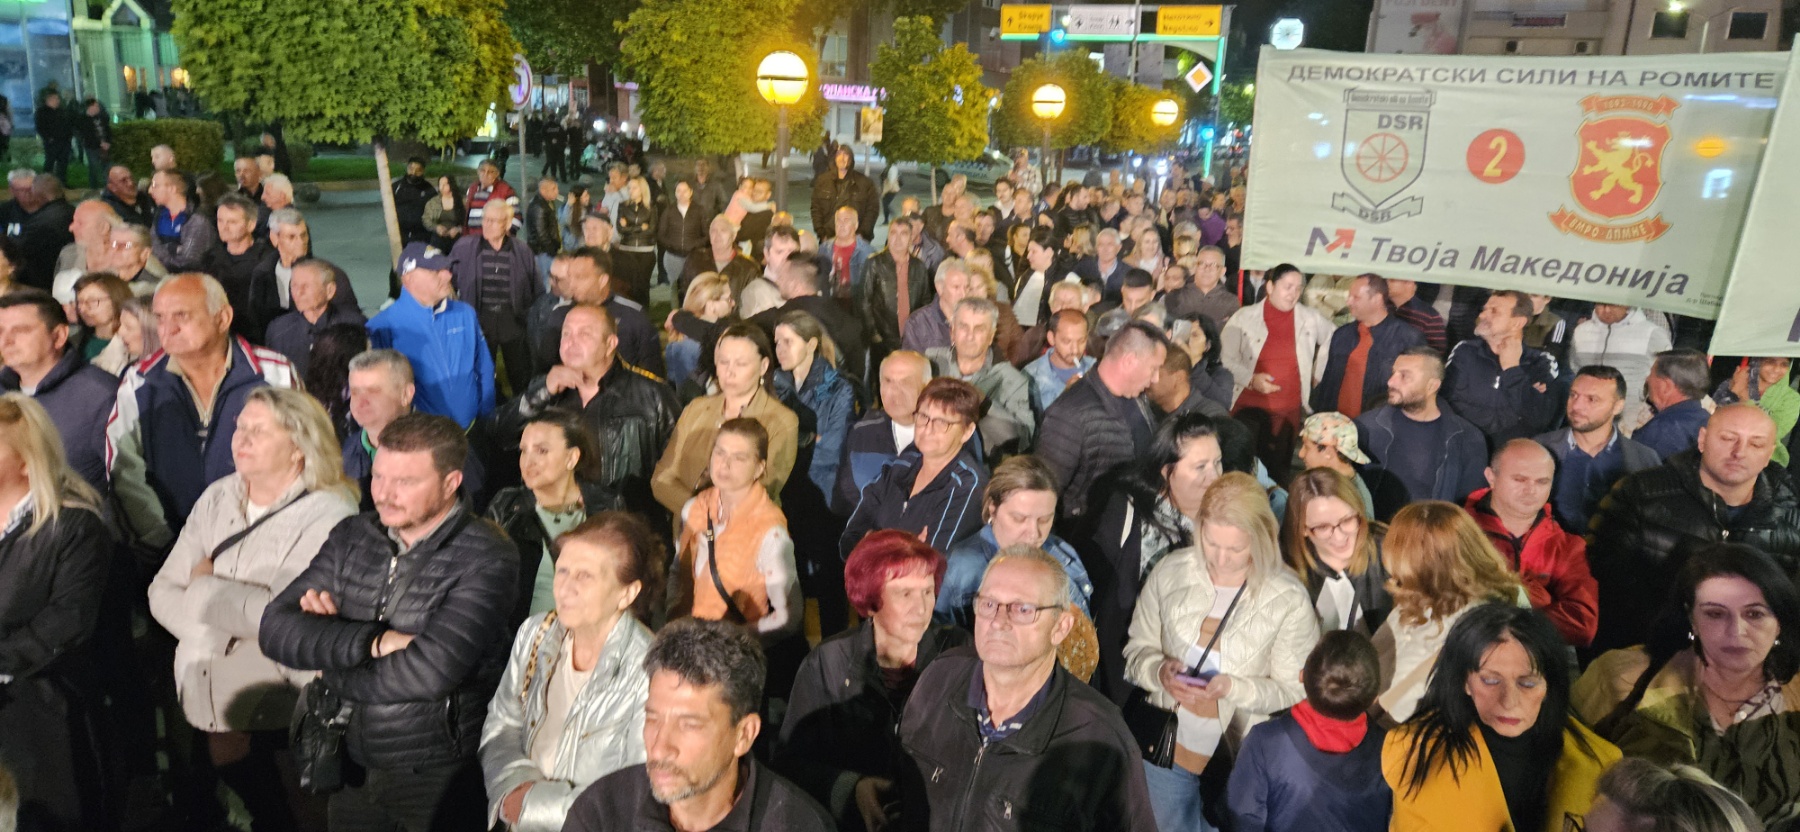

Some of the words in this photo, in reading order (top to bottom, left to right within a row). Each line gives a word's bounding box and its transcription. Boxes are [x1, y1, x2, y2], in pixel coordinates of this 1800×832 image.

[1287, 65, 1486, 84] ДЕМОКРАТСКИ
[1496, 67, 1577, 85] СИЛИ
[1587, 70, 1629, 86] НА
[1639, 71, 1776, 89] РОМИТЕ
[1377, 114, 1424, 130] DSR
[1483, 136, 1507, 177] 2
[1370, 236, 1459, 272] Твоја
[1470, 245, 1689, 298] Македонија
